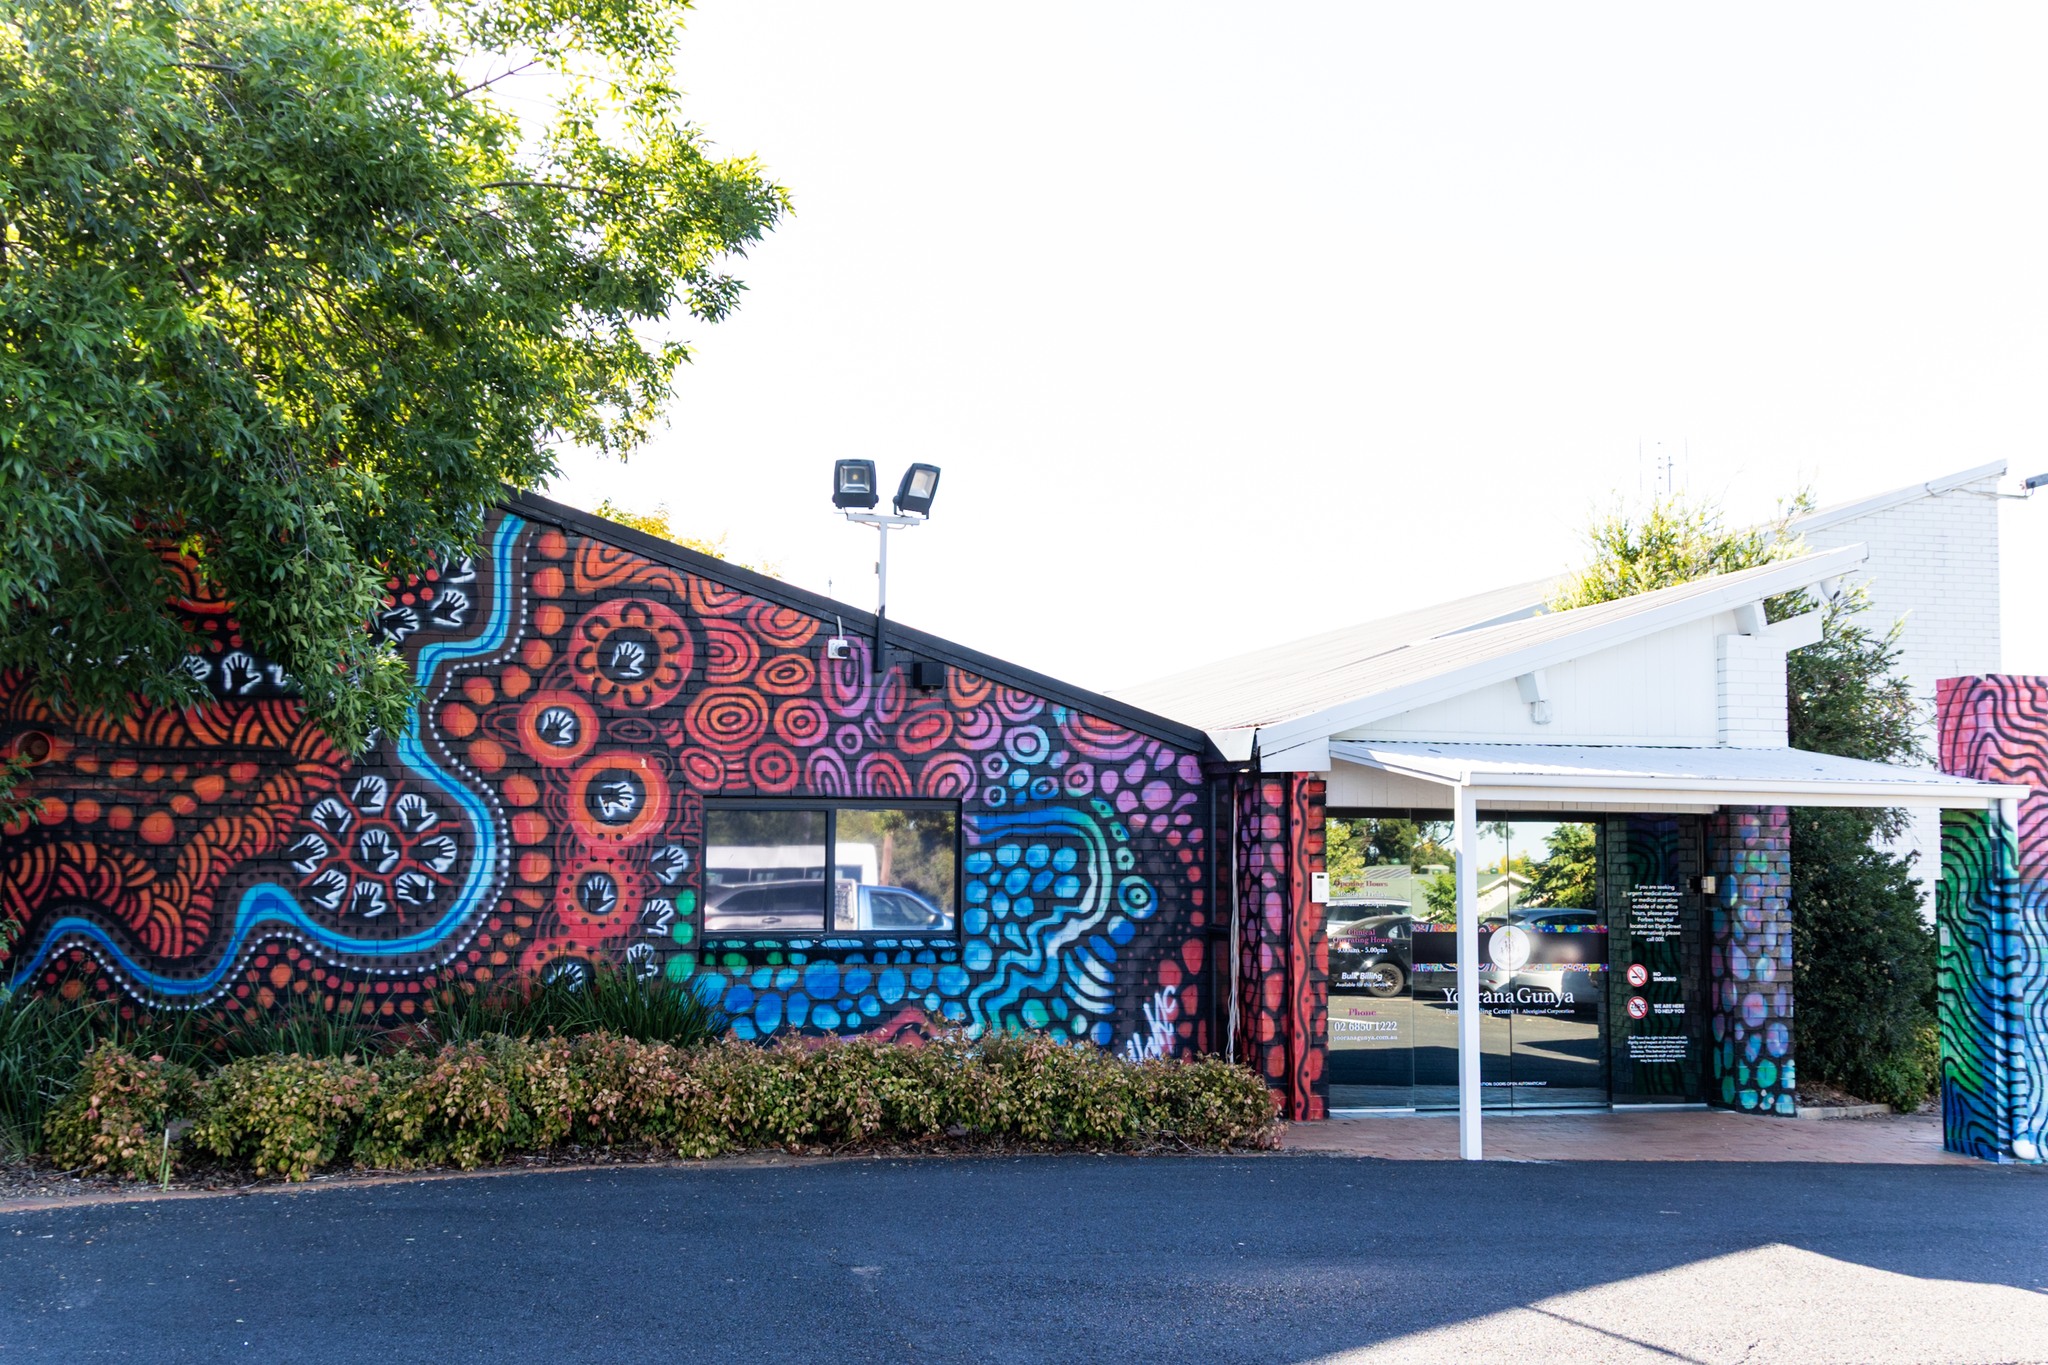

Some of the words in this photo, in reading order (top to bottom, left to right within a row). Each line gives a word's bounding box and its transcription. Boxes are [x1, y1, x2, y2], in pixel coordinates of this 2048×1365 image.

[1332, 937, 1369, 945] Operating
[1365, 947, 1388, 955] 5.00pm
[1360, 972, 1383, 981] Billing
[1517, 987, 1574, 1007] Gunya
[1348, 1008, 1376, 1016] Phone
[1334, 1022, 1346, 1031] 02
[1349, 1022, 1372, 1031] 6850
[1375, 1021, 1397, 1031] 1222
